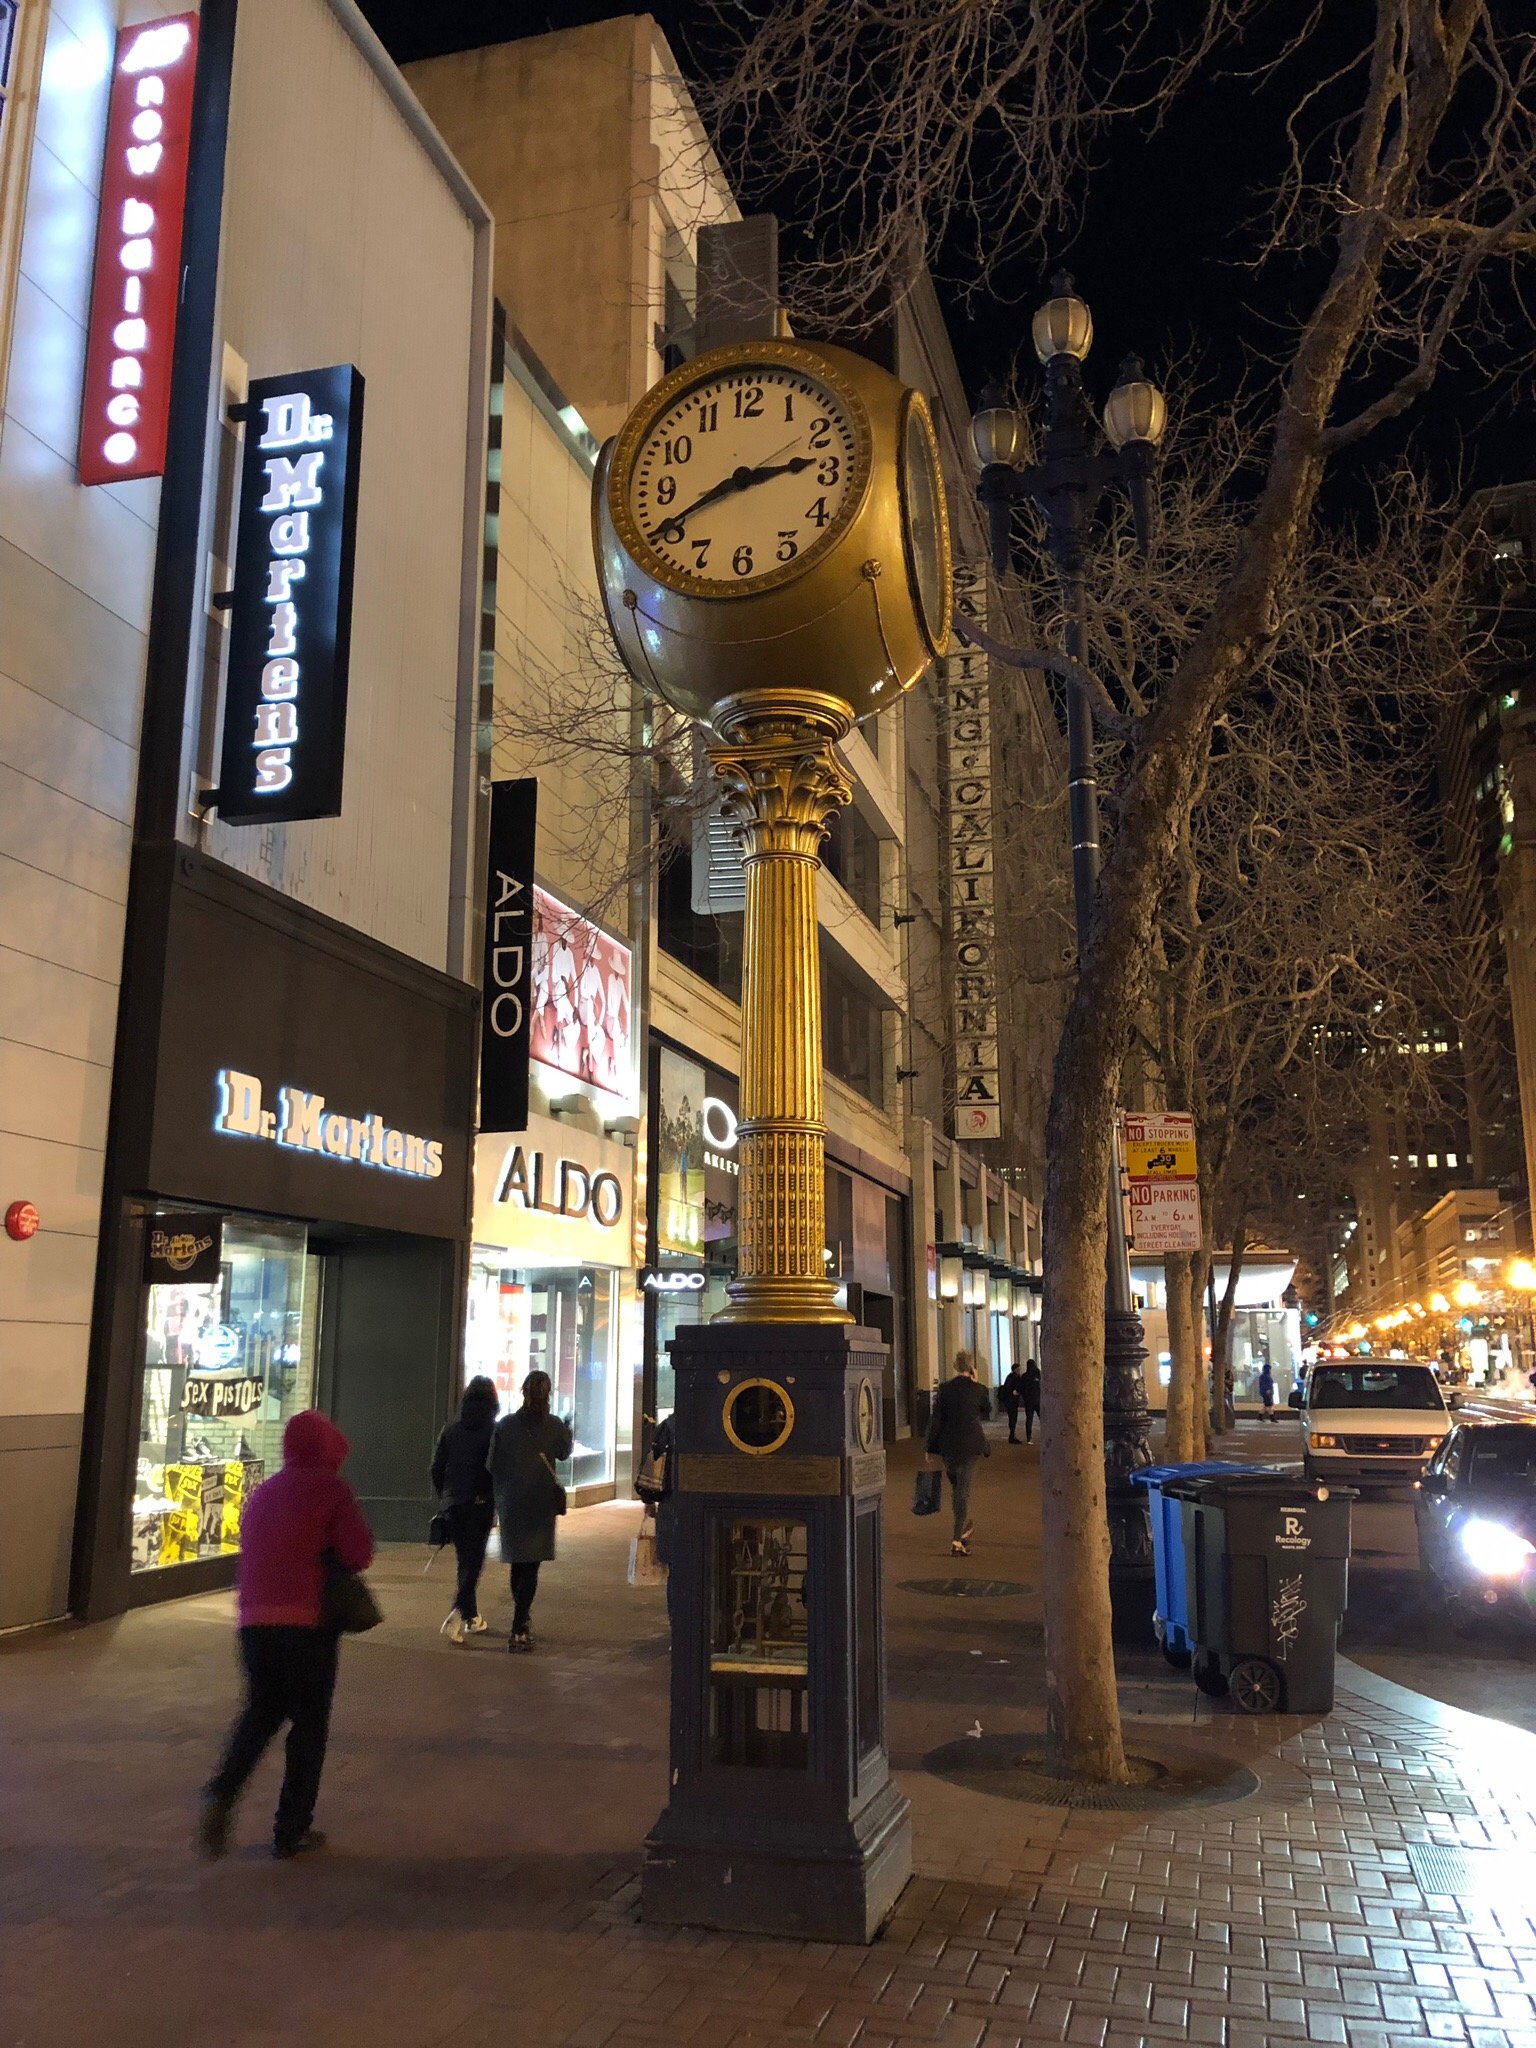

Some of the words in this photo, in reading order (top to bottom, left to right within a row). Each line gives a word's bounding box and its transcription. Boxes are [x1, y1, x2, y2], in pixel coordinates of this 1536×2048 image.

[699, 401, 718, 432] 11
[735, 387, 764, 418] 12
[785, 394, 794, 422] 1
[809, 417, 831, 450] 2
[664, 435, 692, 466] 10
[817, 456, 840, 486] 3
[656, 476, 677, 506] 9
[805, 497, 830, 527] 4
[691, 539, 712, 569] 7
[732, 545, 753, 575] 6
[776, 530, 798, 561] 5
[253, 451, 324, 792] Martens
[491, 870, 525, 1038] ALDO
[954, 782, 994, 1100] CALIFORNIA
[219, 1070, 277, 1140] Dr.
[279, 1087, 443, 1178] Martens
[1128, 1127, 1142, 1140] NO
[1148, 1128, 1189, 1139] STOPPING
[704, 1151, 739, 1176] AKLEY
[498, 1145, 623, 1227] ALDO
[1132, 1186, 1150, 1204] NO
[1153, 1189, 1196, 1203] PARKING
[1136, 1209, 1143, 1222] 2
[1173, 1209, 1180, 1221] 6
[151, 1235, 213, 1258] Martens
[644, 1272, 705, 1289] ALDO
[1275, 1535, 1311, 1546] Recology
